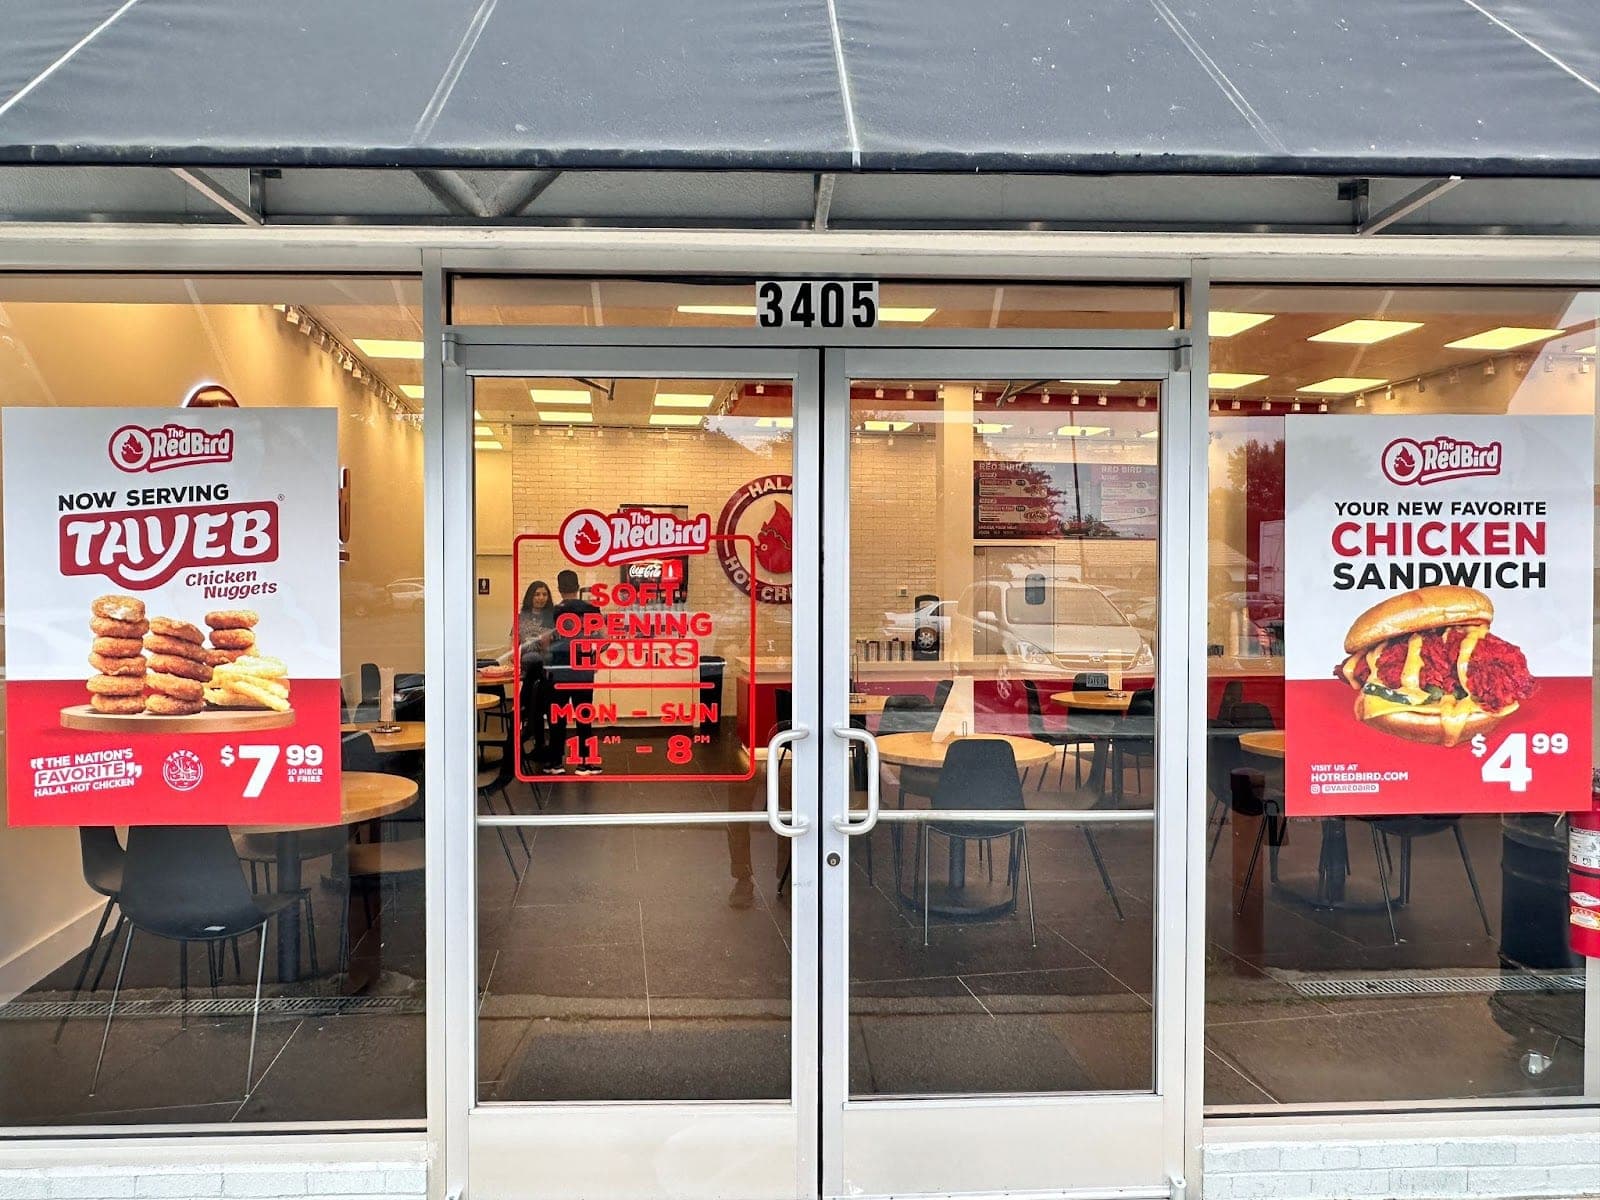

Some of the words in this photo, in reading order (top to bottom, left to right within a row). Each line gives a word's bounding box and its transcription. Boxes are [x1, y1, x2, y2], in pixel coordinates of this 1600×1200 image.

[760, 282, 876, 328] 3405
[151, 430, 230, 458] RedBird
[166, 427, 185, 438] The
[1423, 443, 1498, 470] RedBird
[1437, 440, 1455, 450] The
[58, 491, 117, 511] NOW
[126, 484, 229, 506] SERVING
[1335, 501, 1389, 516] YOUR
[1397, 501, 1443, 516] NEW
[1451, 501, 1547, 515] FAVORITE
[630, 512, 651, 525] The
[66, 509, 272, 582] TAYEB
[611, 517, 707, 550] RedBird
[1331, 521, 1546, 557] CHICKEN
[185, 569, 257, 587] Chicken
[1332, 561, 1546, 590] SANDWICH
[204, 582, 278, 600] Nuggets
[590, 583, 679, 607] SOFT
[556, 612, 713, 637] OPENING
[574, 642, 694, 667] HOURS
[551, 703, 617, 724] MON
[660, 703, 718, 723] SUN
[74, 748, 133, 765] NATION'S
[565, 735, 602, 765] 11
[603, 735, 621, 744] AM
[667, 735, 693, 764] 8
[694, 735, 711, 744] PM
[34, 784, 68, 797] HALAL
[70, 782, 90, 793] HOT
[92, 778, 134, 790] CHICKEN
[1310, 772, 1409, 782] HOTREDBIRD.COM
